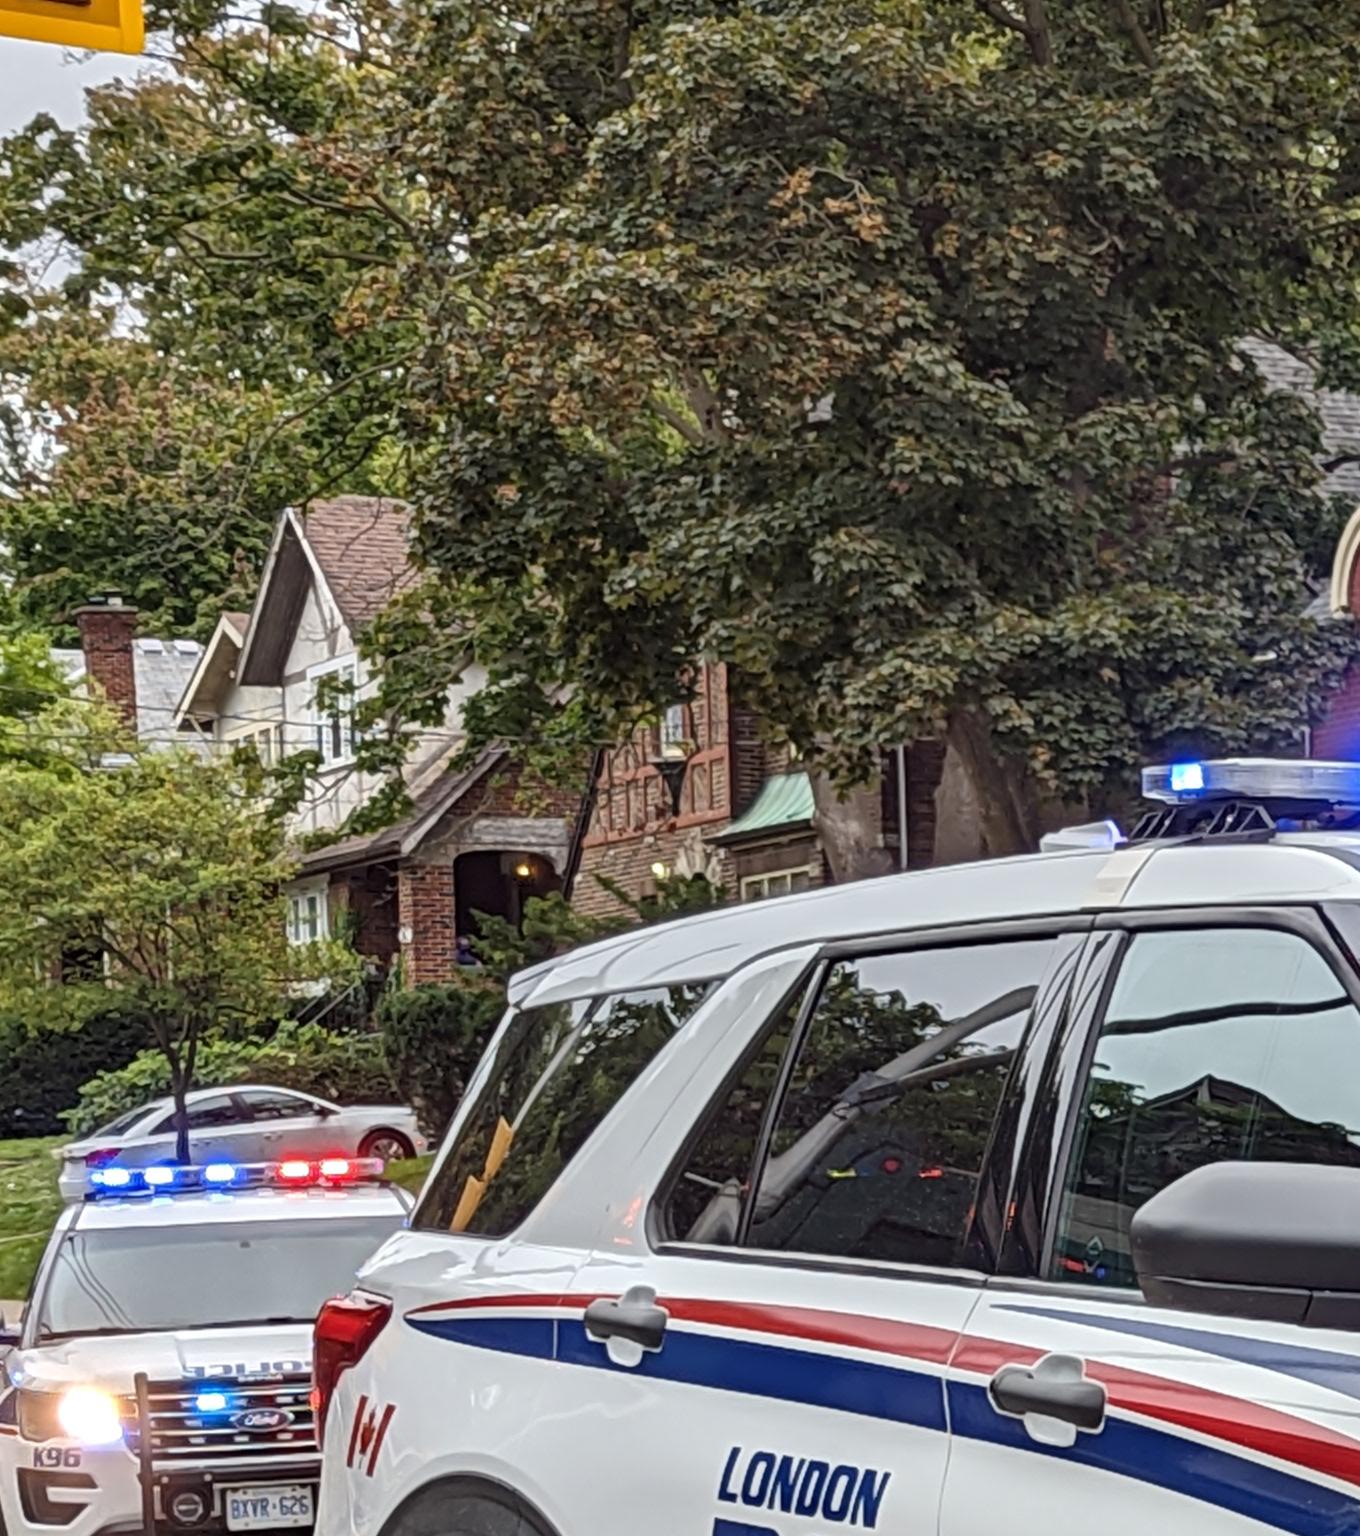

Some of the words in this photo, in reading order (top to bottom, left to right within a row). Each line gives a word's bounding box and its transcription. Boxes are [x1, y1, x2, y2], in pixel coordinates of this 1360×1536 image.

[33, 1447, 81, 1468] K96
[717, 1446, 892, 1530] LONDON
[279, 1495, 309, 1516] 626
